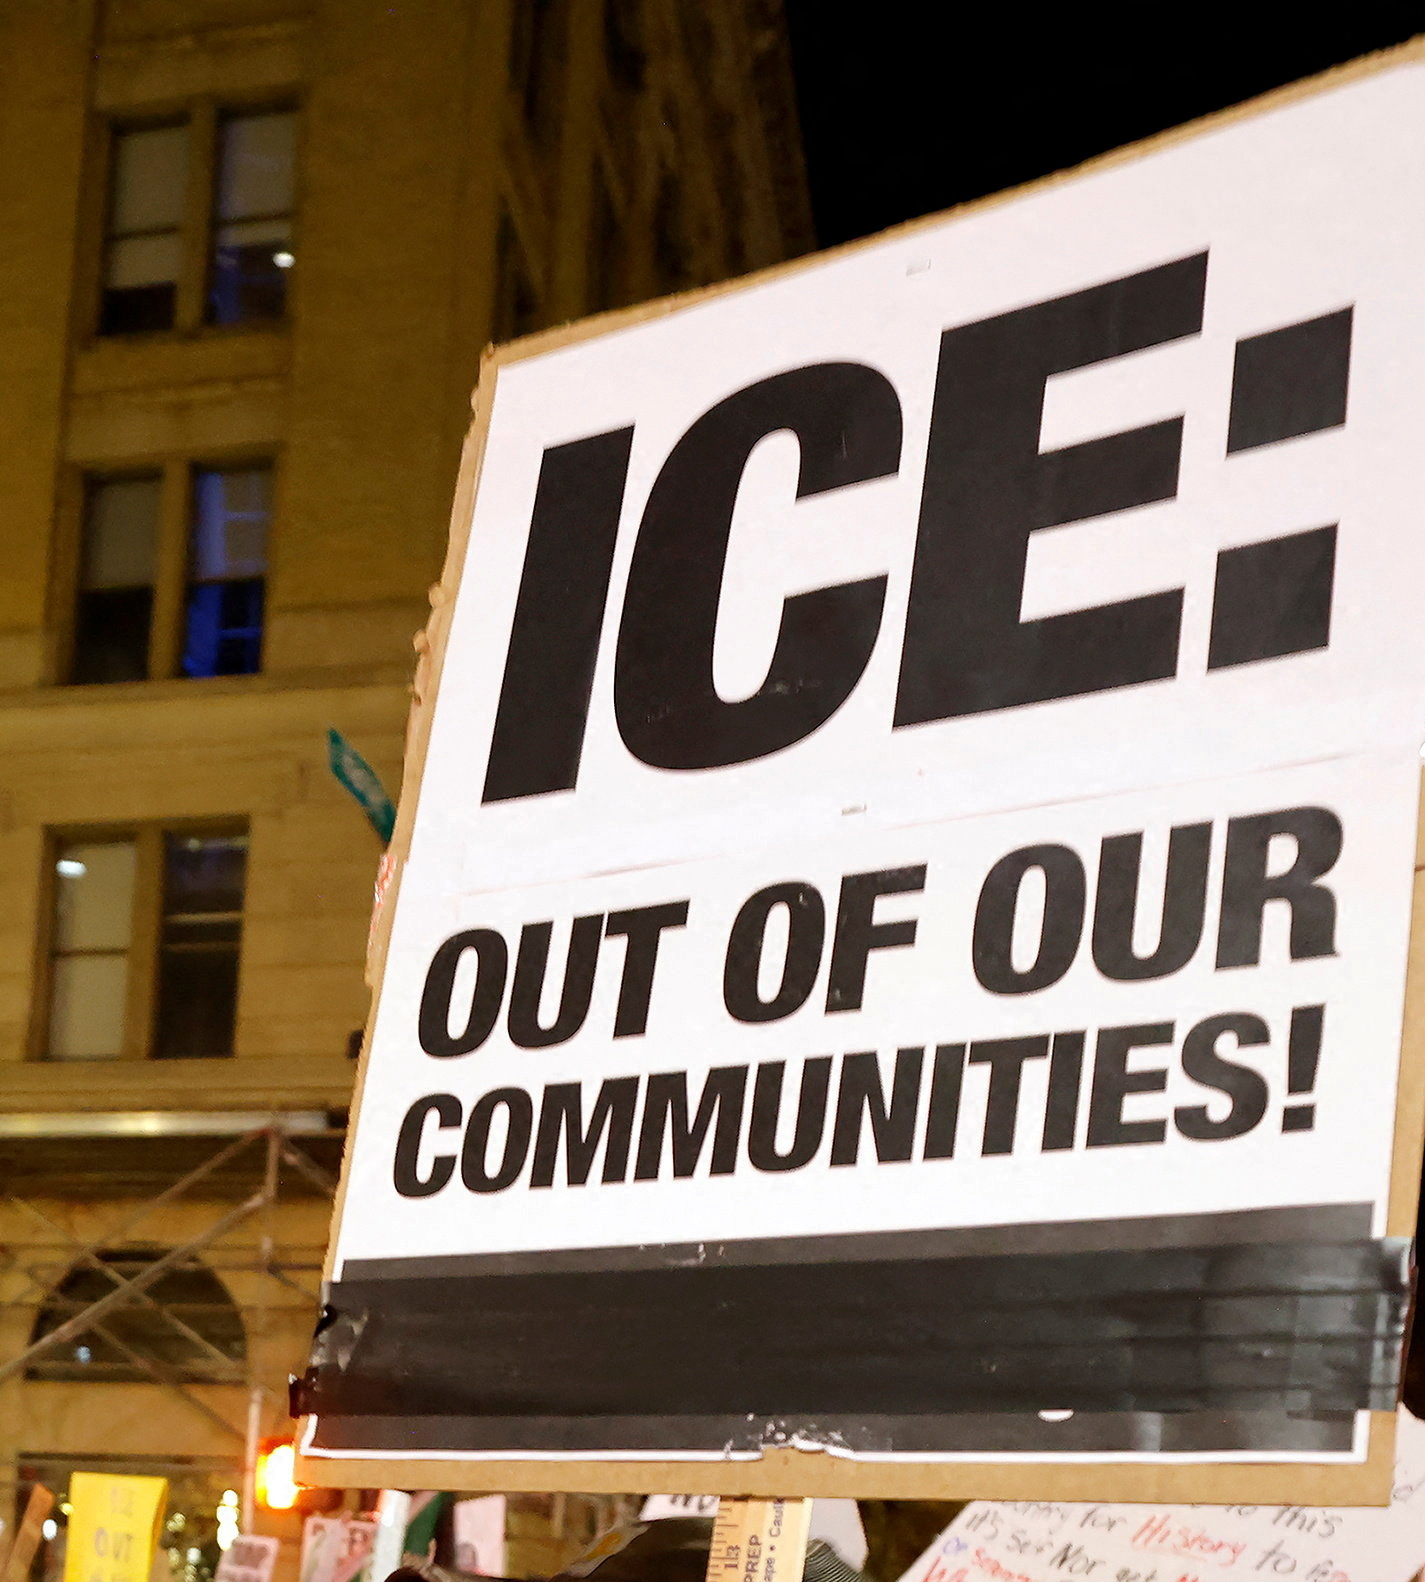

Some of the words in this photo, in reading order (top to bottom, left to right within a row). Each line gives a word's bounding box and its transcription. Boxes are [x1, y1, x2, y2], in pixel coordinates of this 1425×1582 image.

[480, 249, 1355, 807] ICE:
[417, 899, 688, 1058] OUT
[722, 863, 926, 1021] OF
[972, 806, 1345, 995] OUR
[392, 1005, 1324, 1198] COMMUNITIES!
[1255, 1539, 1297, 1575] to
